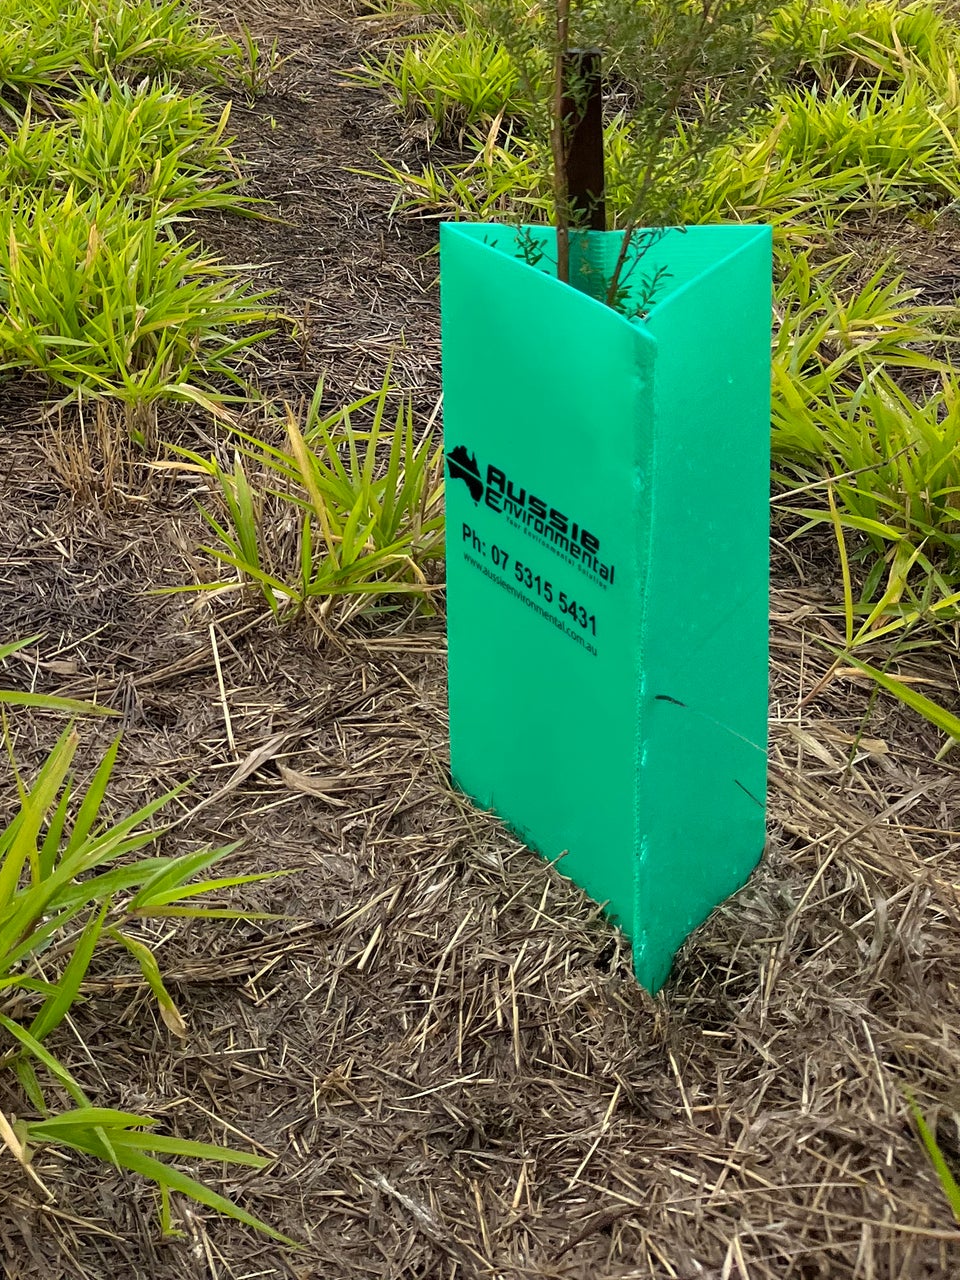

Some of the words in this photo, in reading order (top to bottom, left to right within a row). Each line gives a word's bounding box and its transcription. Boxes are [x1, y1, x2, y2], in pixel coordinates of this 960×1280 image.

[484, 486, 615, 585] Environmental
[486, 463, 600, 555] Aussie
[462, 522, 487, 556] Ph:
[491, 543, 509, 570] 07
[514, 560, 553, 603] 5315
[558, 594, 597, 636] 5431
[463, 551, 598, 657] www.aussieenvironmental.com.au
